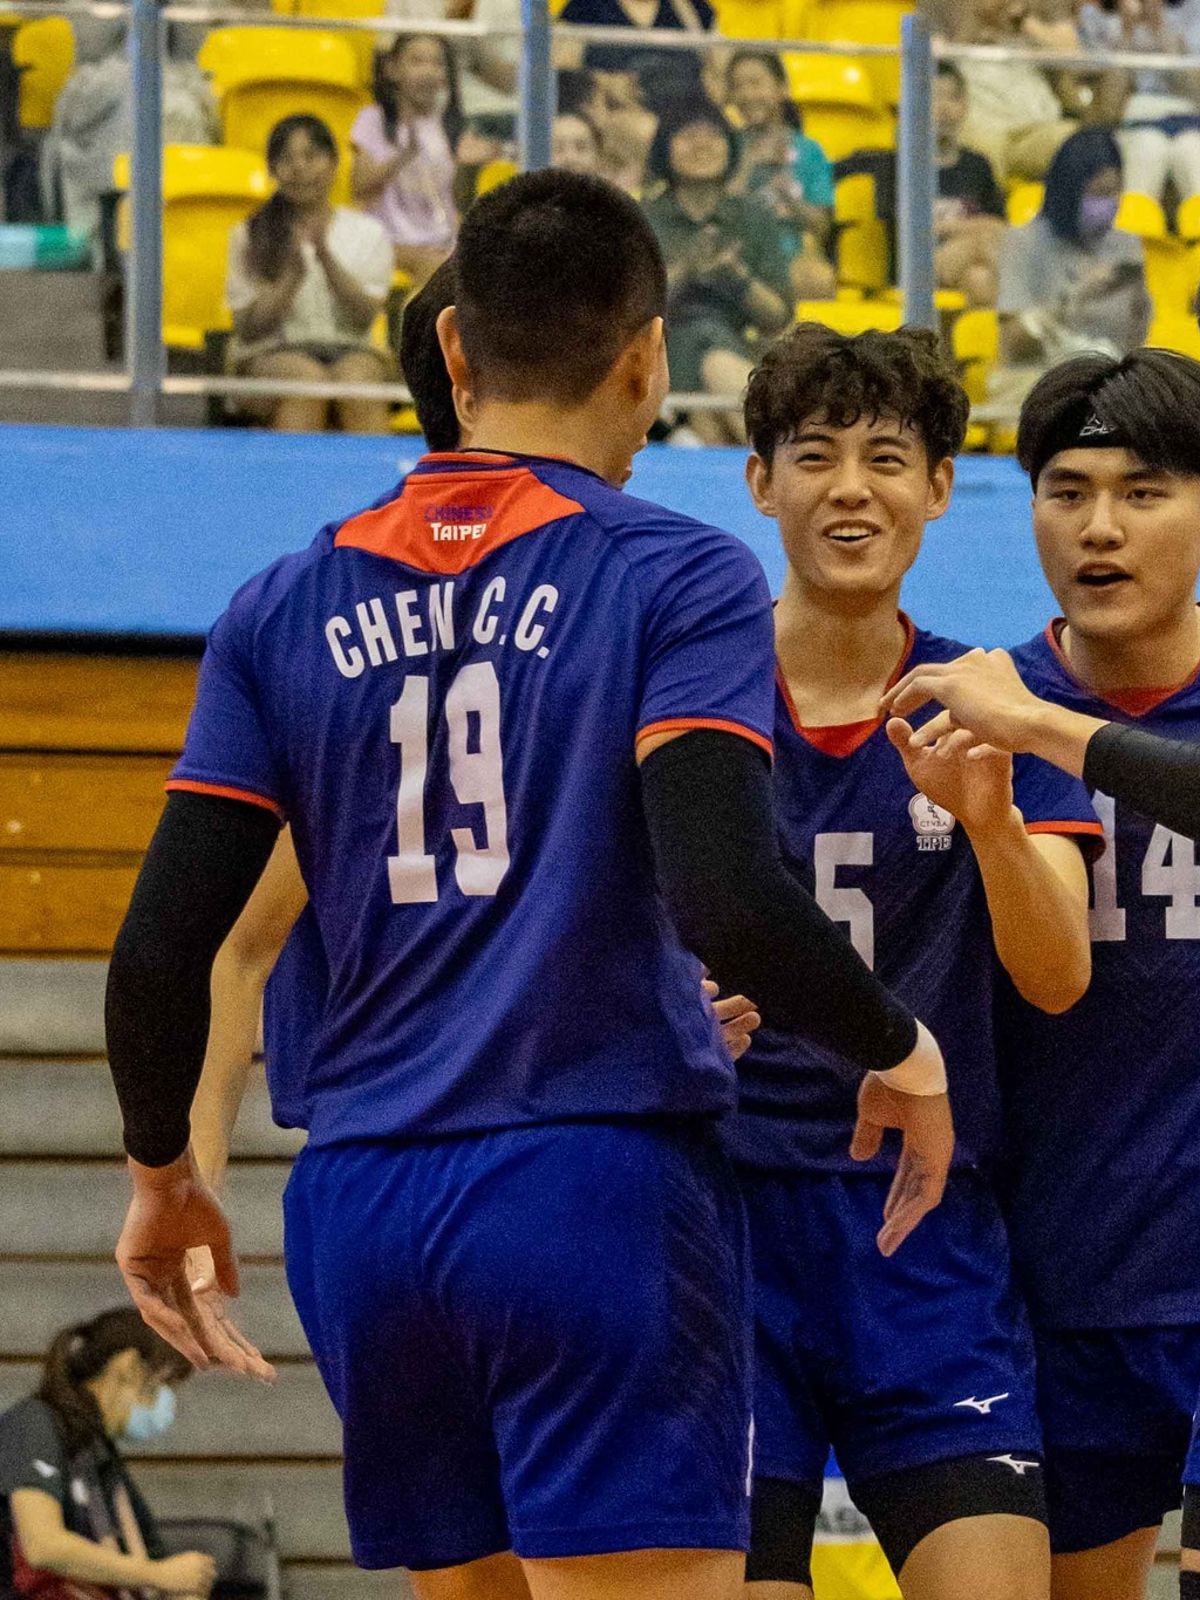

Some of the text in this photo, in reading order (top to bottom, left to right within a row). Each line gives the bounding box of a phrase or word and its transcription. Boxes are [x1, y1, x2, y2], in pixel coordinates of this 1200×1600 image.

[430, 522, 487, 541] TAIPEI
[325, 581, 455, 679] CHEN
[387, 660, 511, 904] 19
[916, 835, 952, 851] TPE
[814, 832, 874, 973] 5
